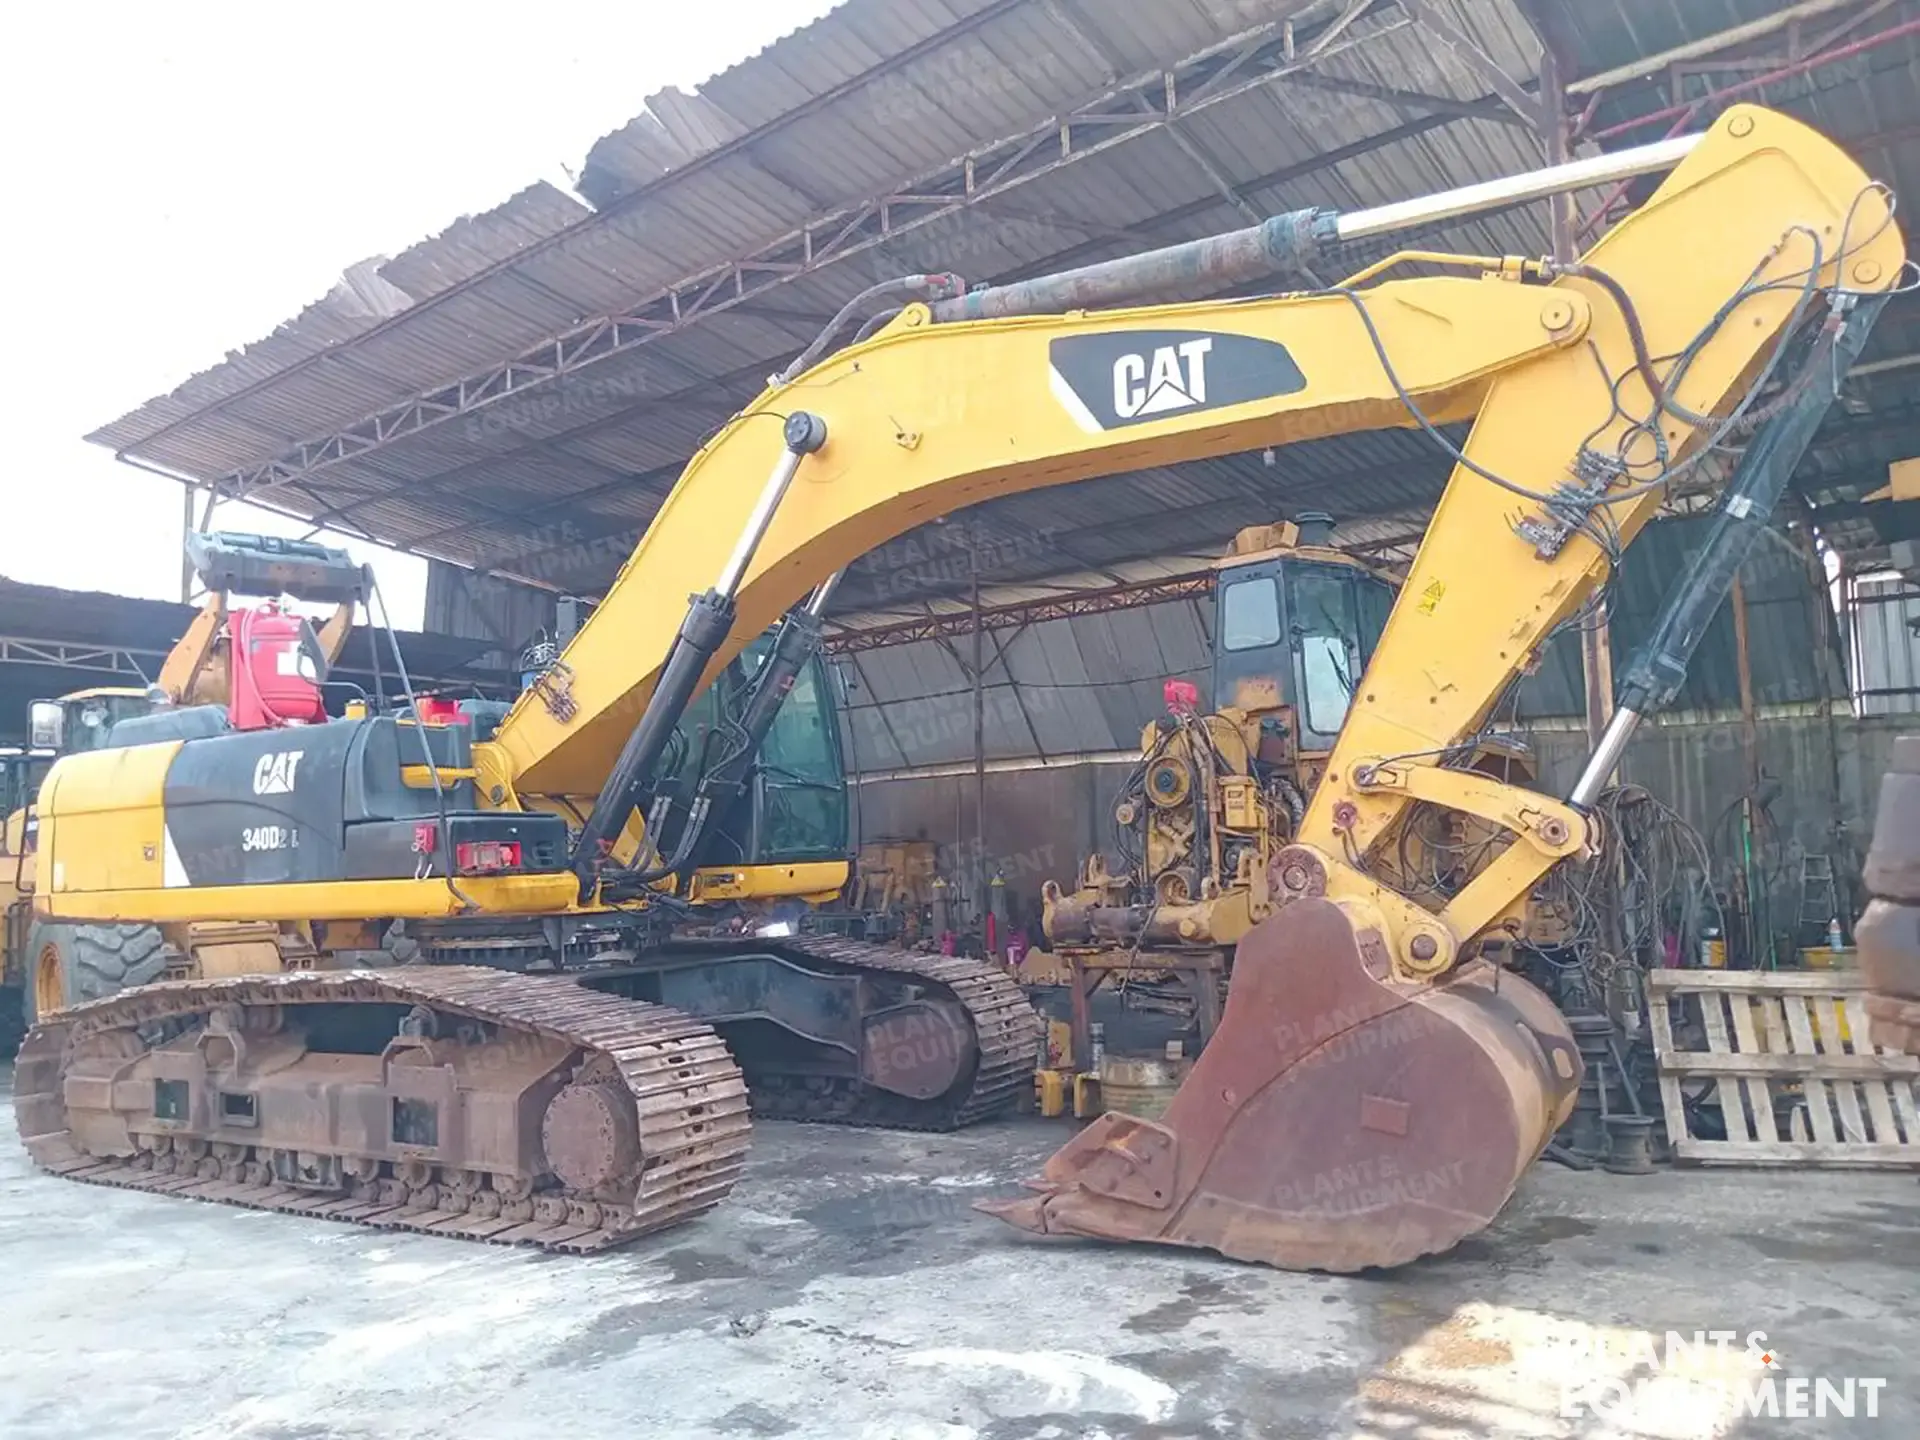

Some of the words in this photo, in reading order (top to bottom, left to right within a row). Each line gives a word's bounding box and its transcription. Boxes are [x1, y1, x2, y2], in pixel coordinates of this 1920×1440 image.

[1113, 337, 1213, 418] CAT
[253, 750, 305, 796] CAT
[242, 825, 287, 852] 340D2
